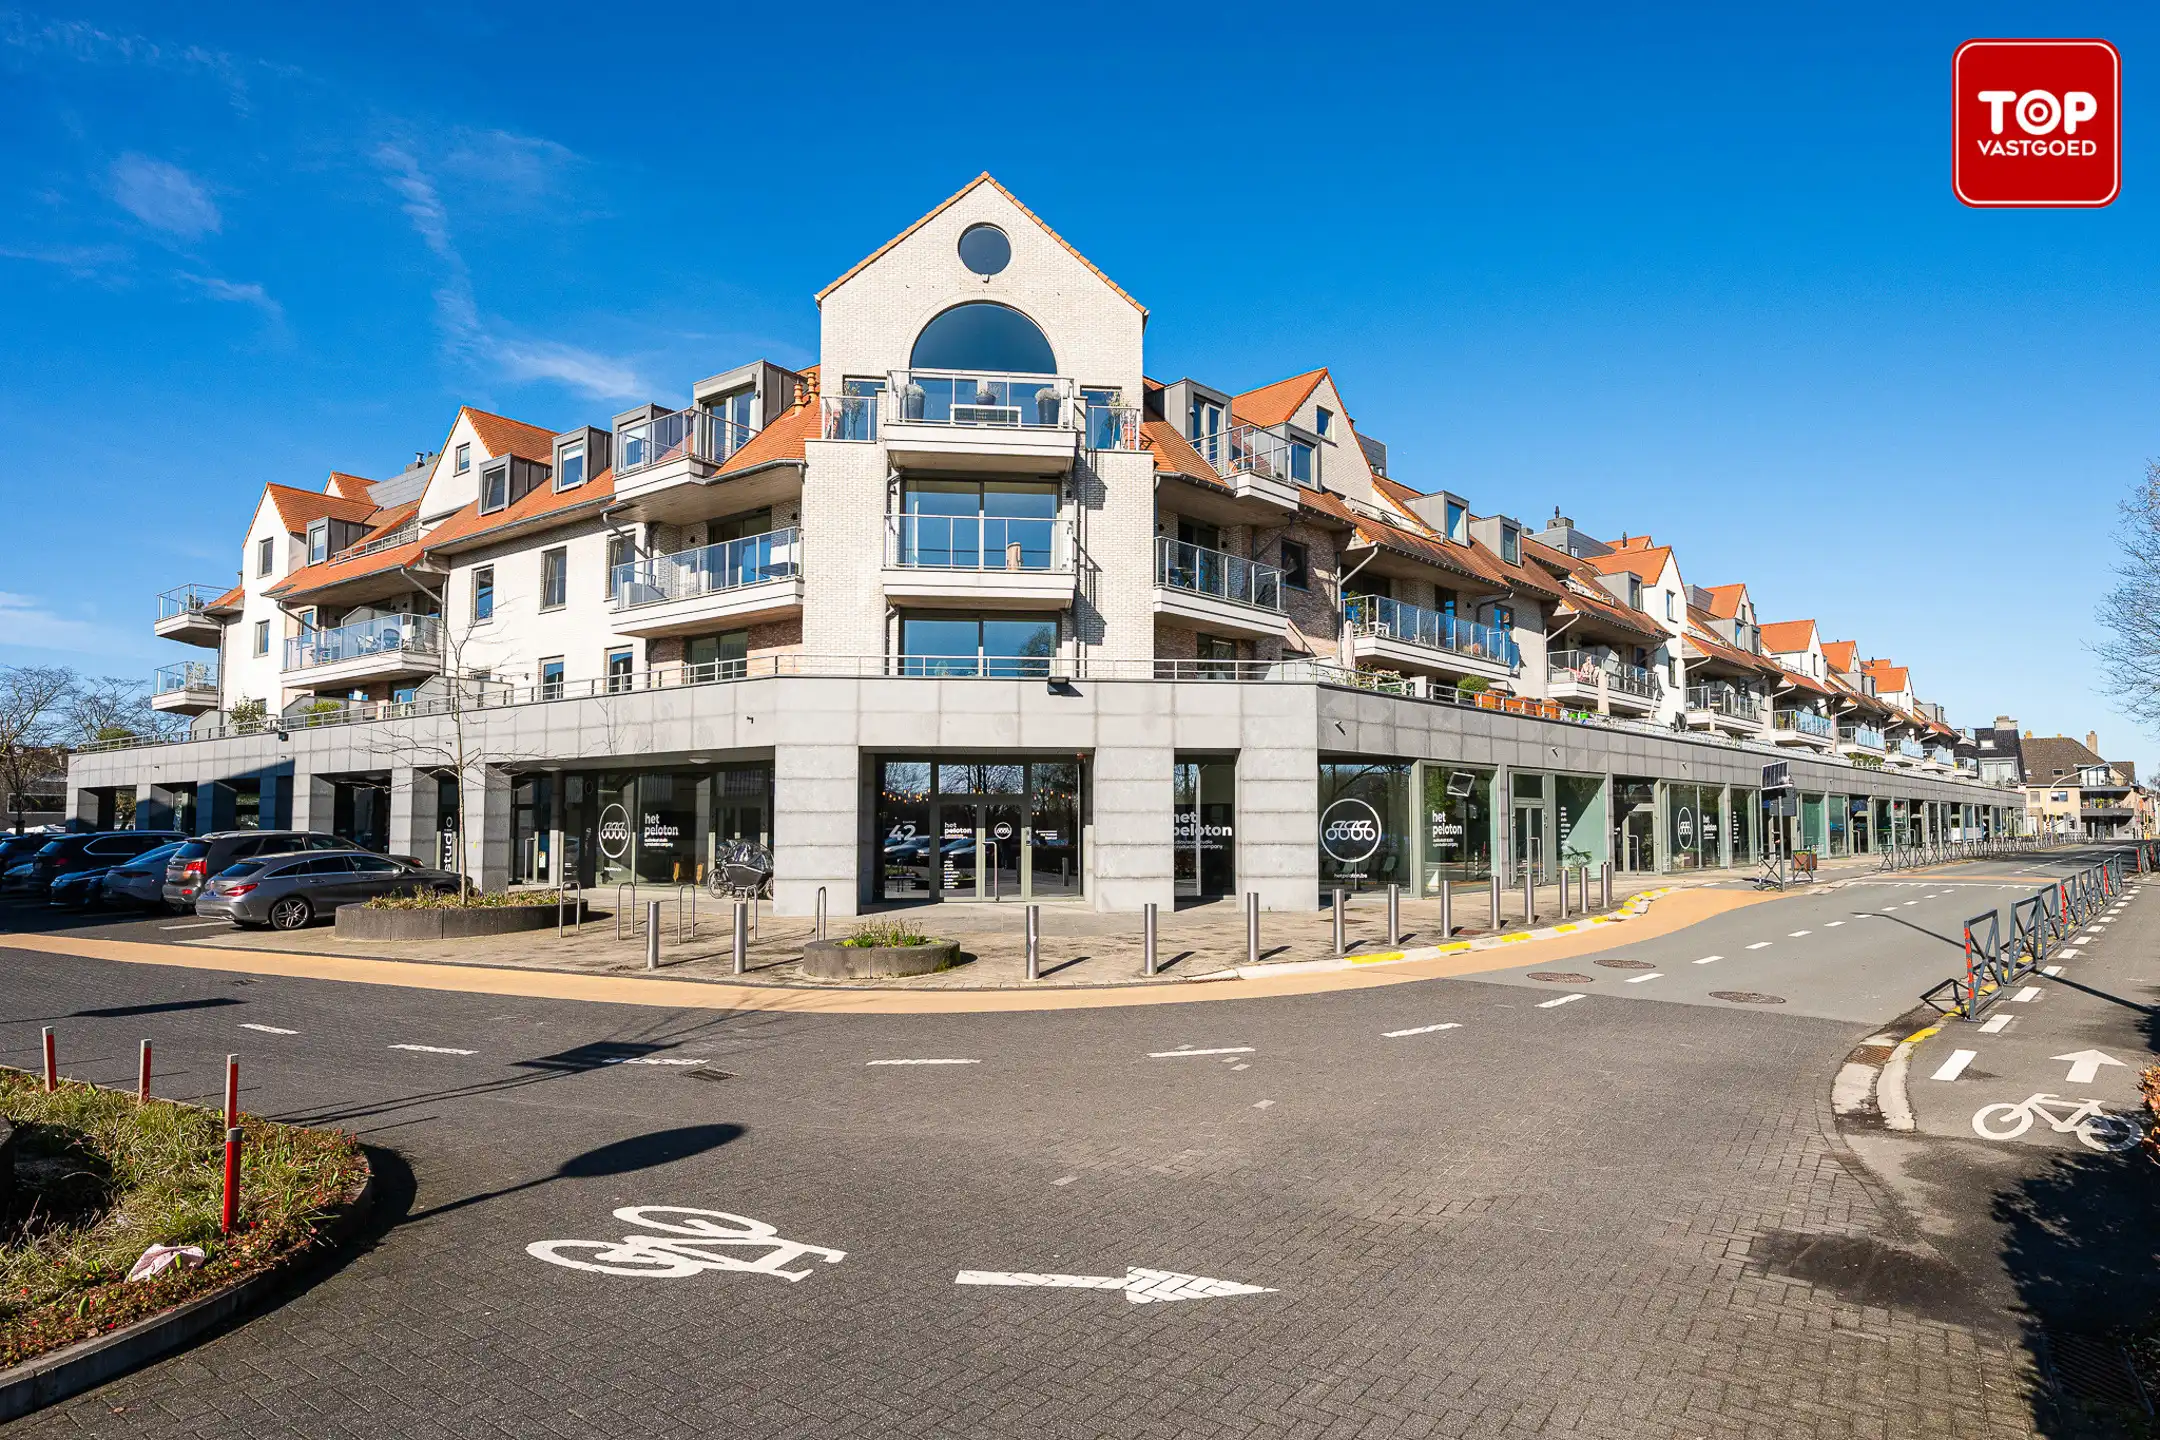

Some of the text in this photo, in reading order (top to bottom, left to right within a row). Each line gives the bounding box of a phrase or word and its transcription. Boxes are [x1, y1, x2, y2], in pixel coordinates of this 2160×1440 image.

[644, 812, 660, 824] het
[1432, 810, 1446, 822] het
[644, 824, 679, 838] peloton
[889, 824, 916, 841] 42
[1432, 822, 1463, 838] peloton
[443, 816, 453, 872] studio
